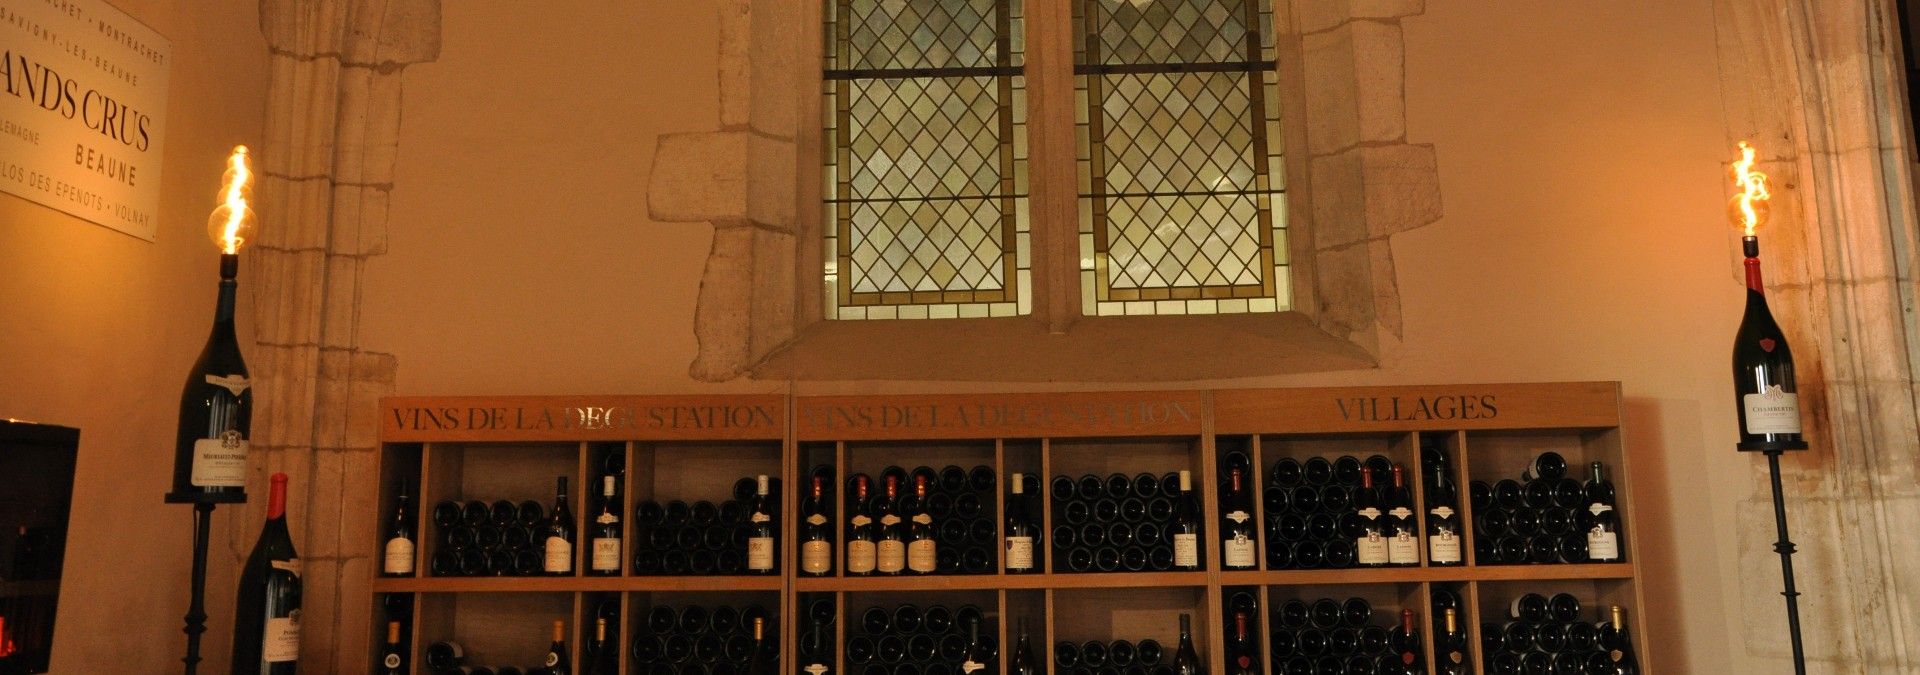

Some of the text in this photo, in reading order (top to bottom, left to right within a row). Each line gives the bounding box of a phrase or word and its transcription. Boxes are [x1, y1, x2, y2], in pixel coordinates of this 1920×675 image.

[0, 7, 137, 87] SAVIGNY-LES-BEAUNE
[99, 18, 164, 66] MONTRACHET
[82, 88, 150, 152] CRUS
[75, 143, 137, 187] BEAUNE
[29, 171, 51, 192] DES
[55, 181, 103, 211] EPENOTS
[115, 205, 150, 227] VOLNAY
[393, 407, 459, 431] VINS
[467, 407, 507, 431] DE
[516, 406, 554, 431] LA
[881, 404, 922, 429] DE
[930, 404, 969, 431] LA
[1335, 394, 1498, 423] VILLAGES
